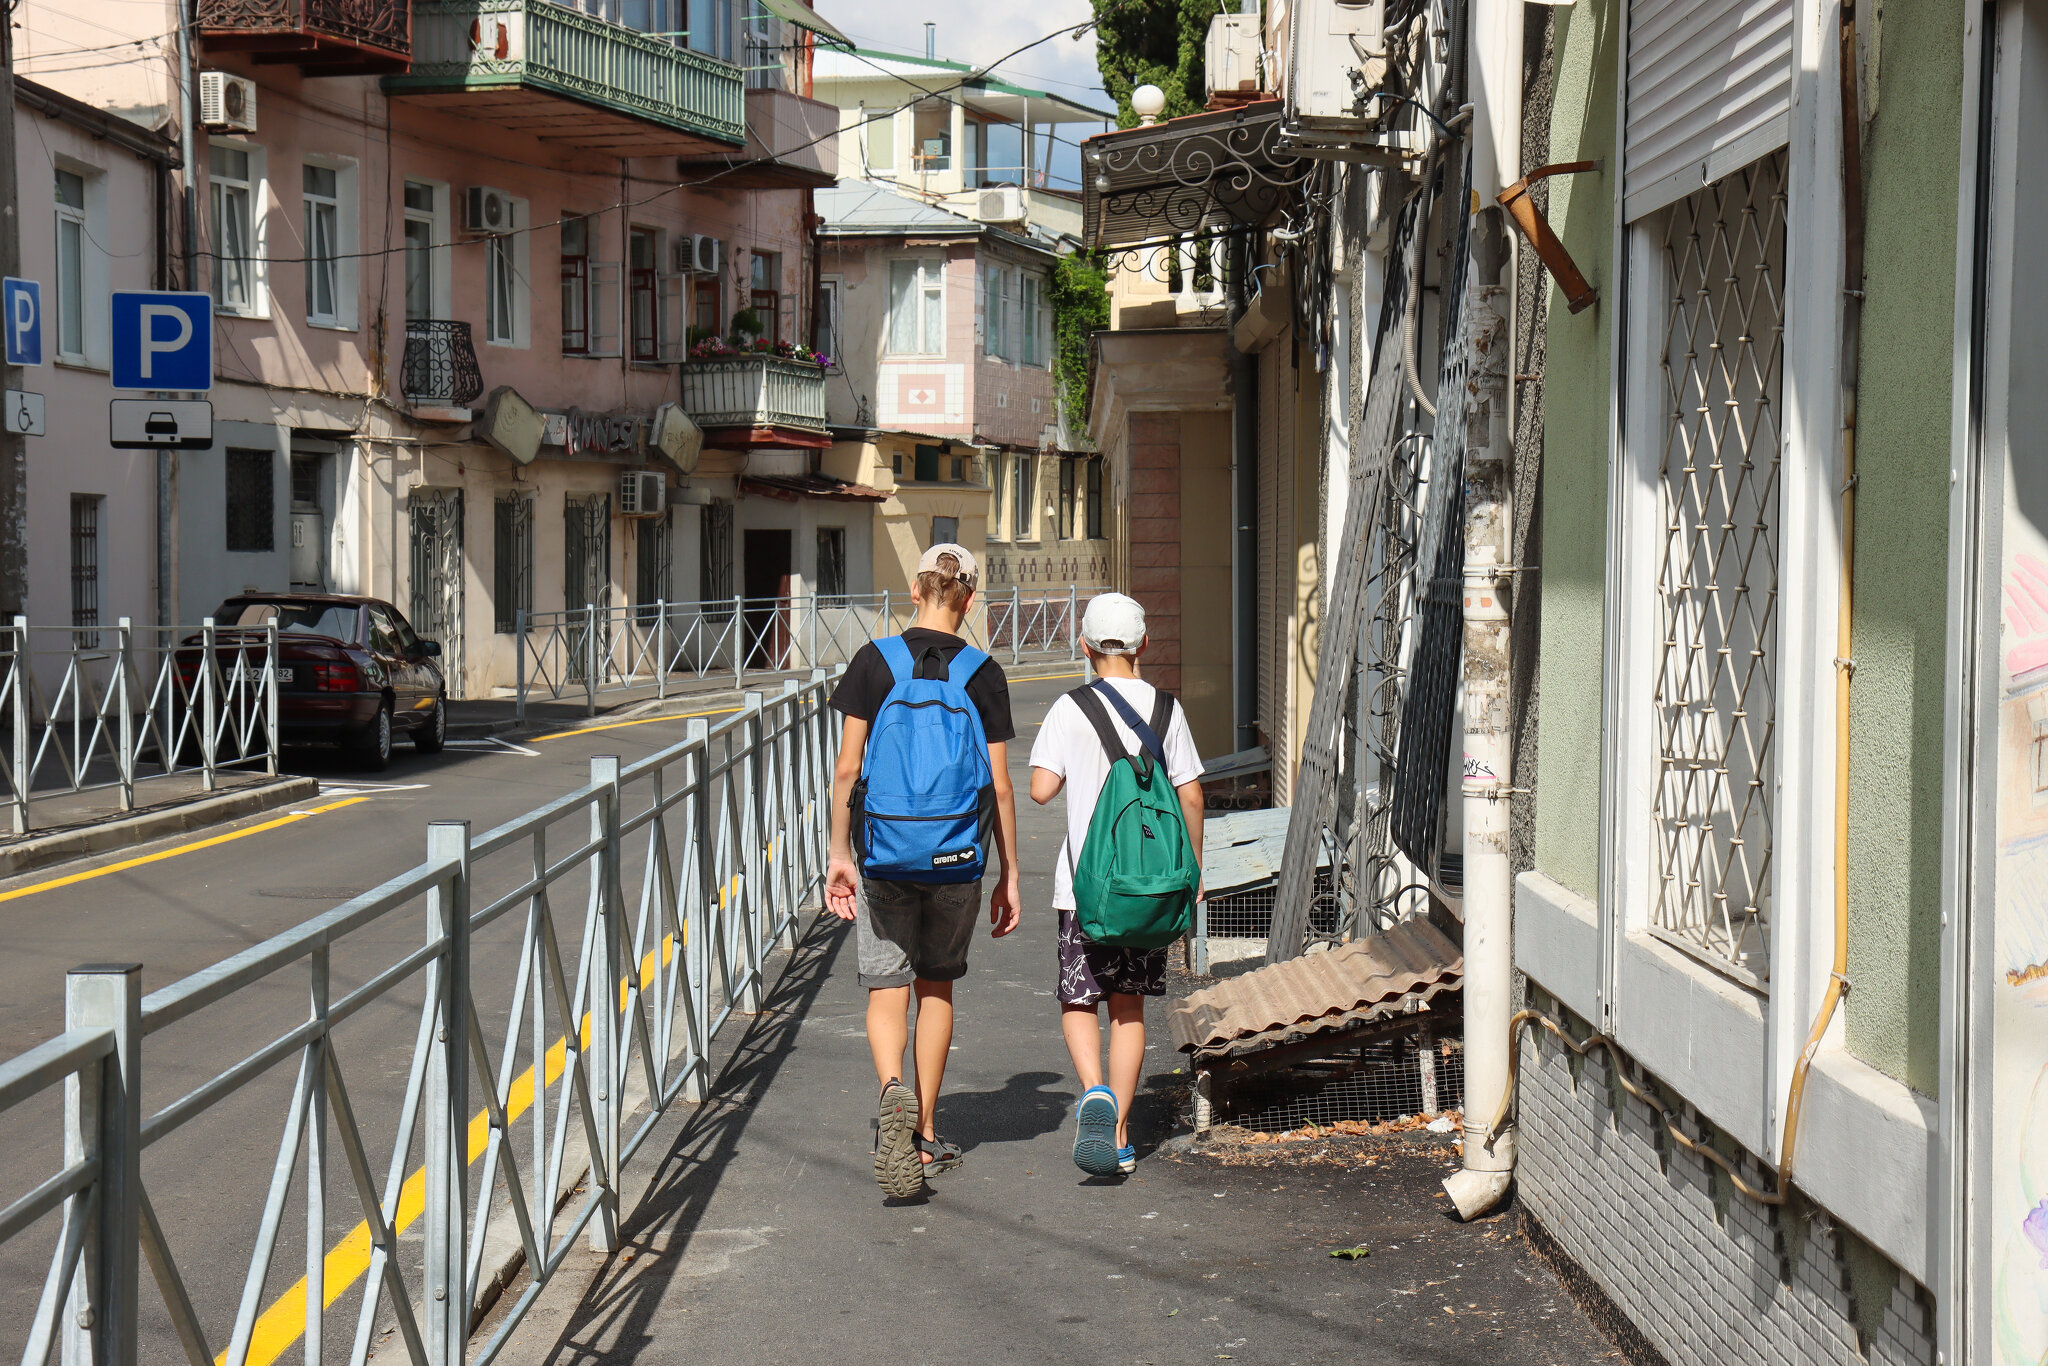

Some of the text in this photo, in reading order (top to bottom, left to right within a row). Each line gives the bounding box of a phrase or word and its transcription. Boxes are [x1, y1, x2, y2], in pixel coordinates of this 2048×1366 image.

[14, 289, 35, 355] P
[140, 304, 193, 379] P
[278, 669, 289, 678] 82
[934, 854, 957, 865] arena
